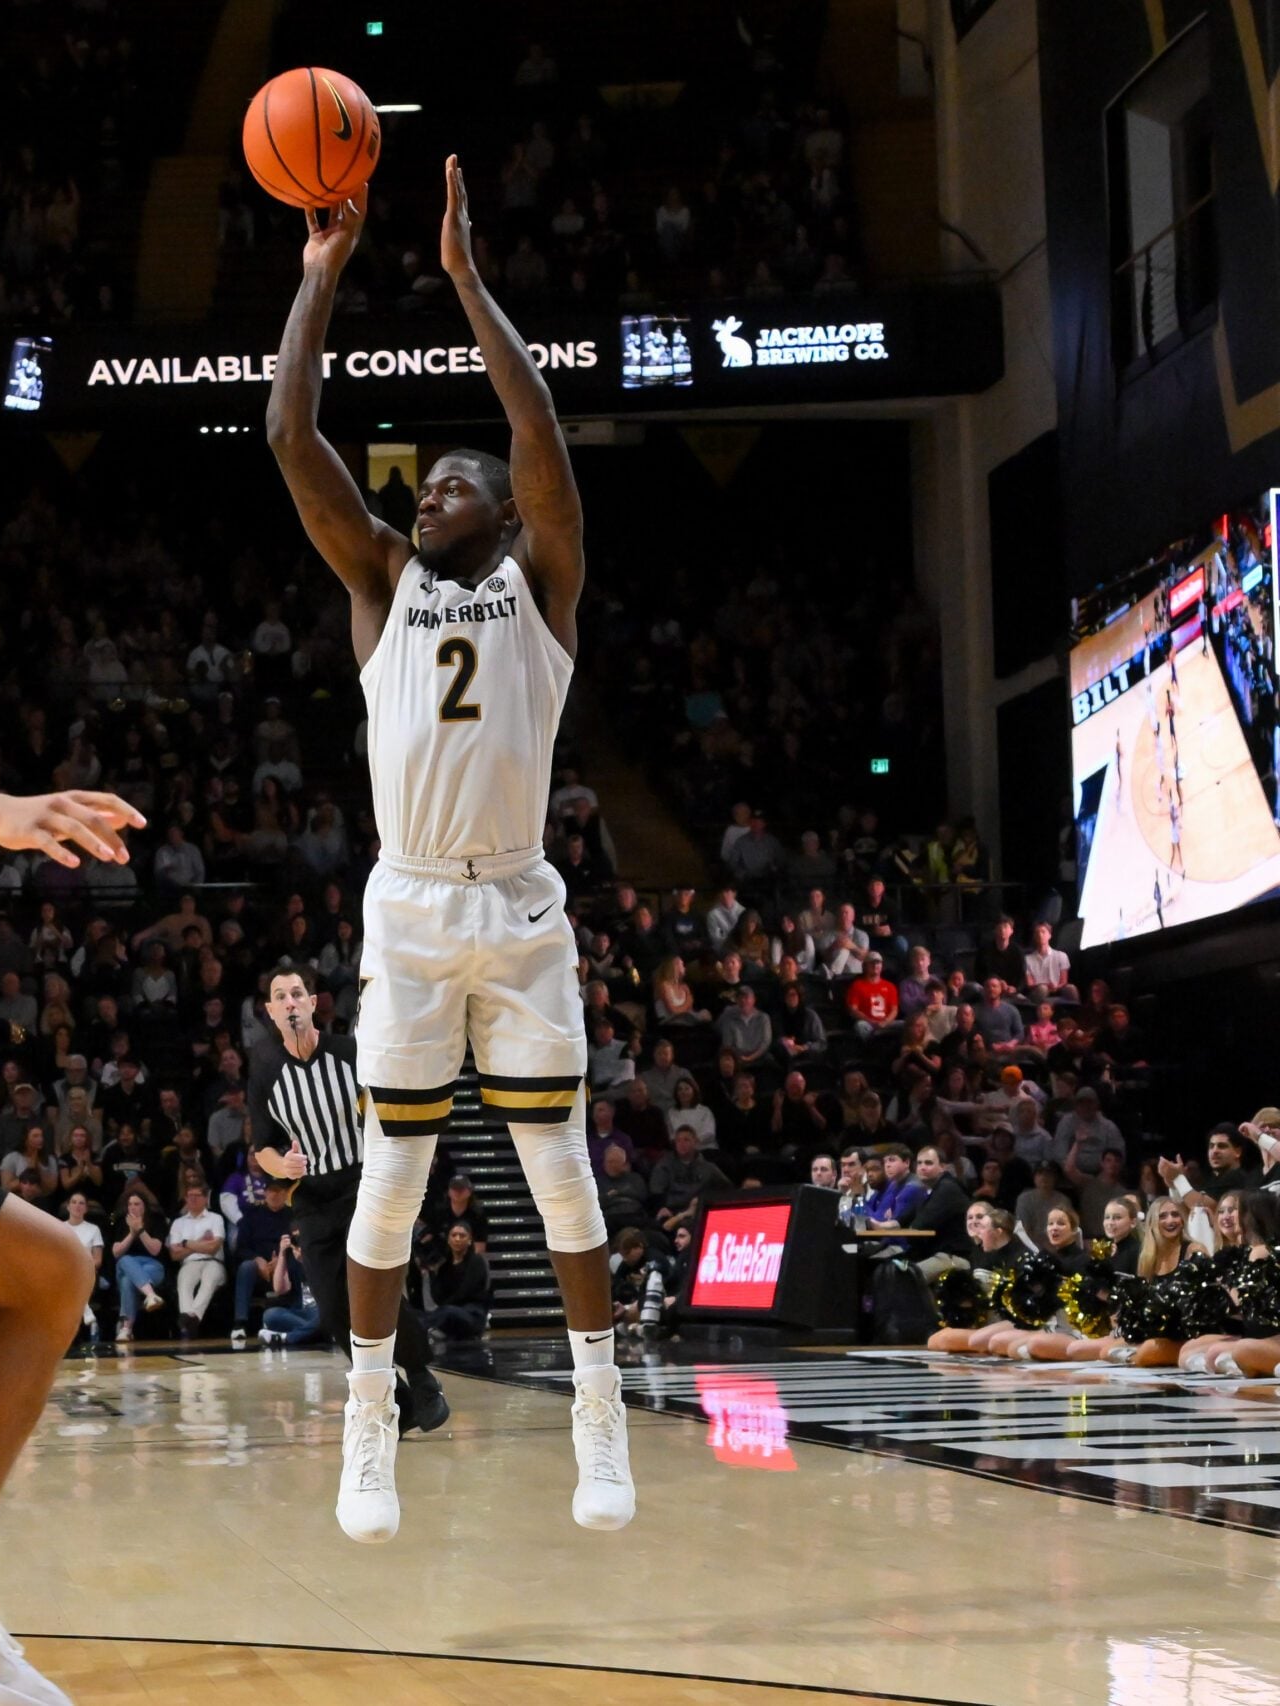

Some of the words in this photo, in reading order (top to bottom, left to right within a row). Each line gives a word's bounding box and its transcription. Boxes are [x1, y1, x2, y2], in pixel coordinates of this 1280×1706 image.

[756, 323, 884, 347] JACKALOPE
[87, 353, 278, 386] AVAILABLE
[322, 352, 338, 379] T
[345, 340, 598, 378] CONCESONS
[757, 344, 849, 366] BREWING
[854, 343, 889, 360] CO.
[408, 598, 516, 629] VANERBILT
[437, 637, 482, 723] 2
